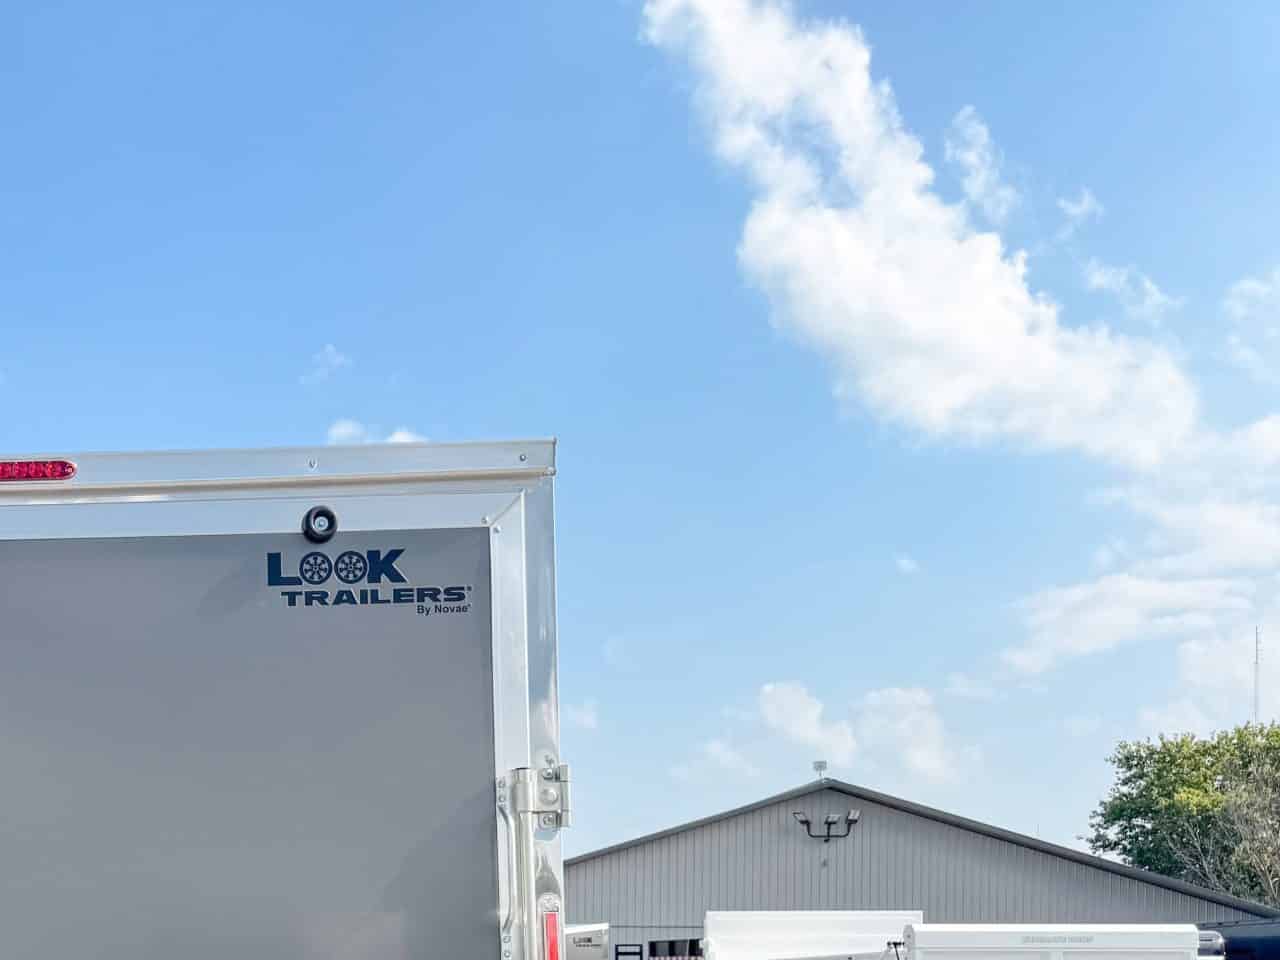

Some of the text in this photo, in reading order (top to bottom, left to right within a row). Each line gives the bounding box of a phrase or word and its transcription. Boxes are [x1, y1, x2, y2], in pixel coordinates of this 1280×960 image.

[267, 548, 408, 586] LOOK
[281, 586, 467, 607] TRAILERS
[416, 604, 469, 616] By Novae
